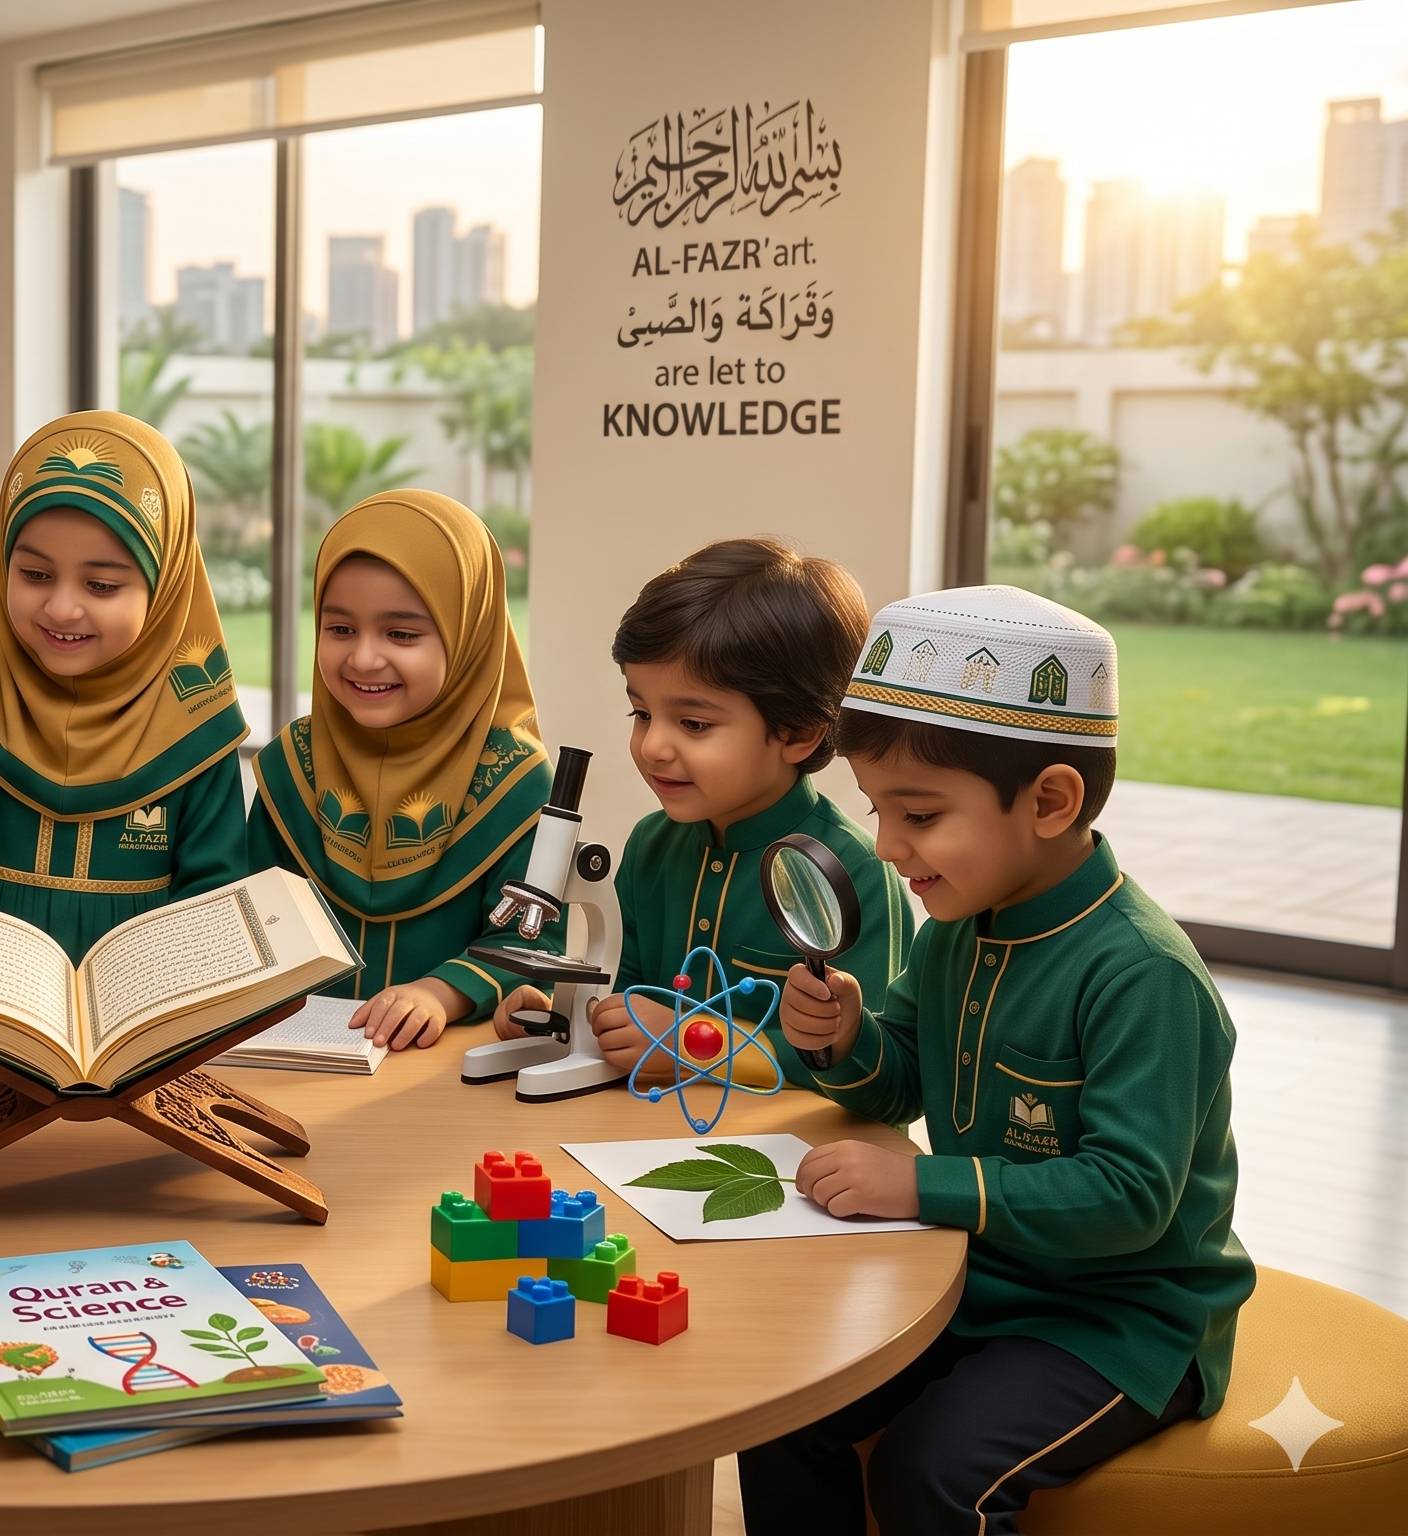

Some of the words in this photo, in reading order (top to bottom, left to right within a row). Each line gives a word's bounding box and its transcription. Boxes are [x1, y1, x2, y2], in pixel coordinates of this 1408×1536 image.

[654, 364, 700, 387] are
[708, 355, 746, 386] let
[754, 357, 786, 385] to
[603, 398, 841, 437] KNOWLEDGE
[8, 1279, 138, 1303] Quran
[143, 1276, 169, 1290] &
[11, 1294, 188, 1323] Science
